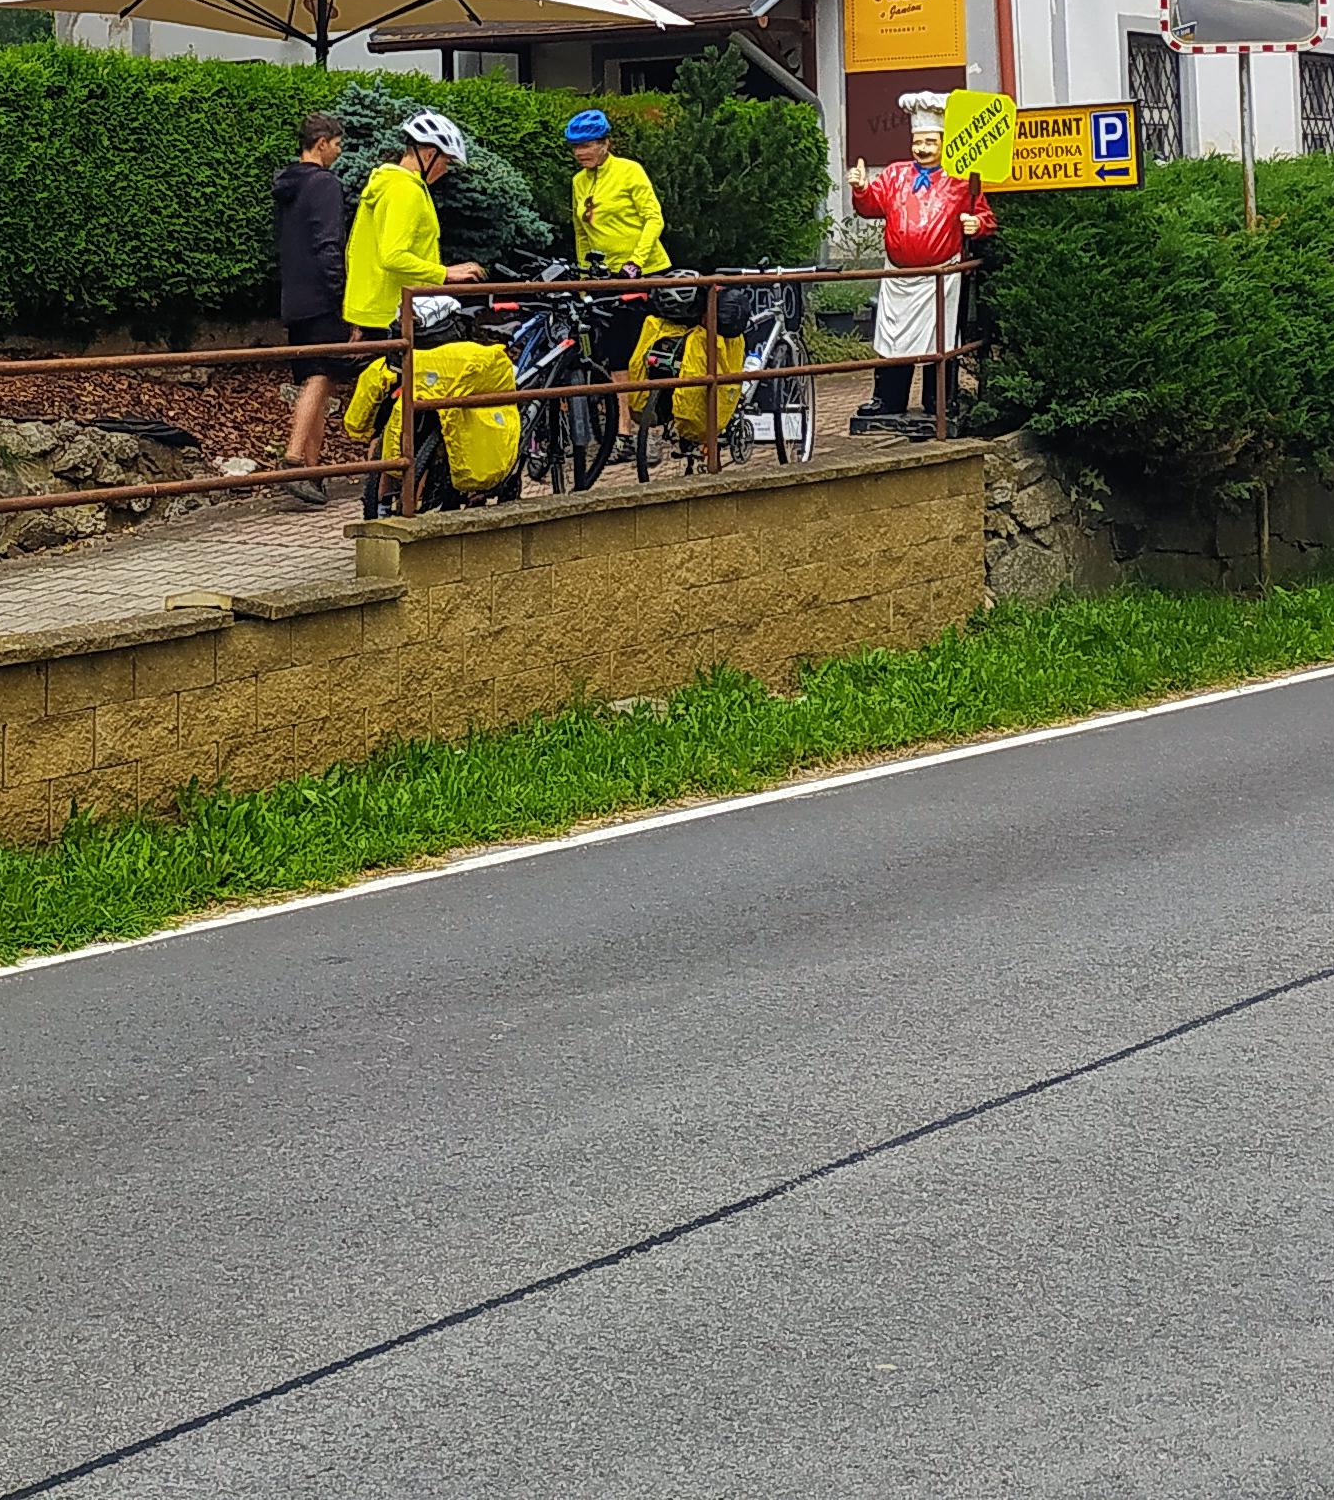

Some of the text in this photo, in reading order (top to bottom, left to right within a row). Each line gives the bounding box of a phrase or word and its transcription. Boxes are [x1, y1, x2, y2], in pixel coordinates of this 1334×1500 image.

[945, 98, 1002, 159] OTEVŘENO
[955, 114, 1010, 174] GEÖFFNET
[1015, 117, 1083, 140] AURANT
[1099, 116, 1123, 156] P
[1012, 162, 1083, 181] U KAPLE
